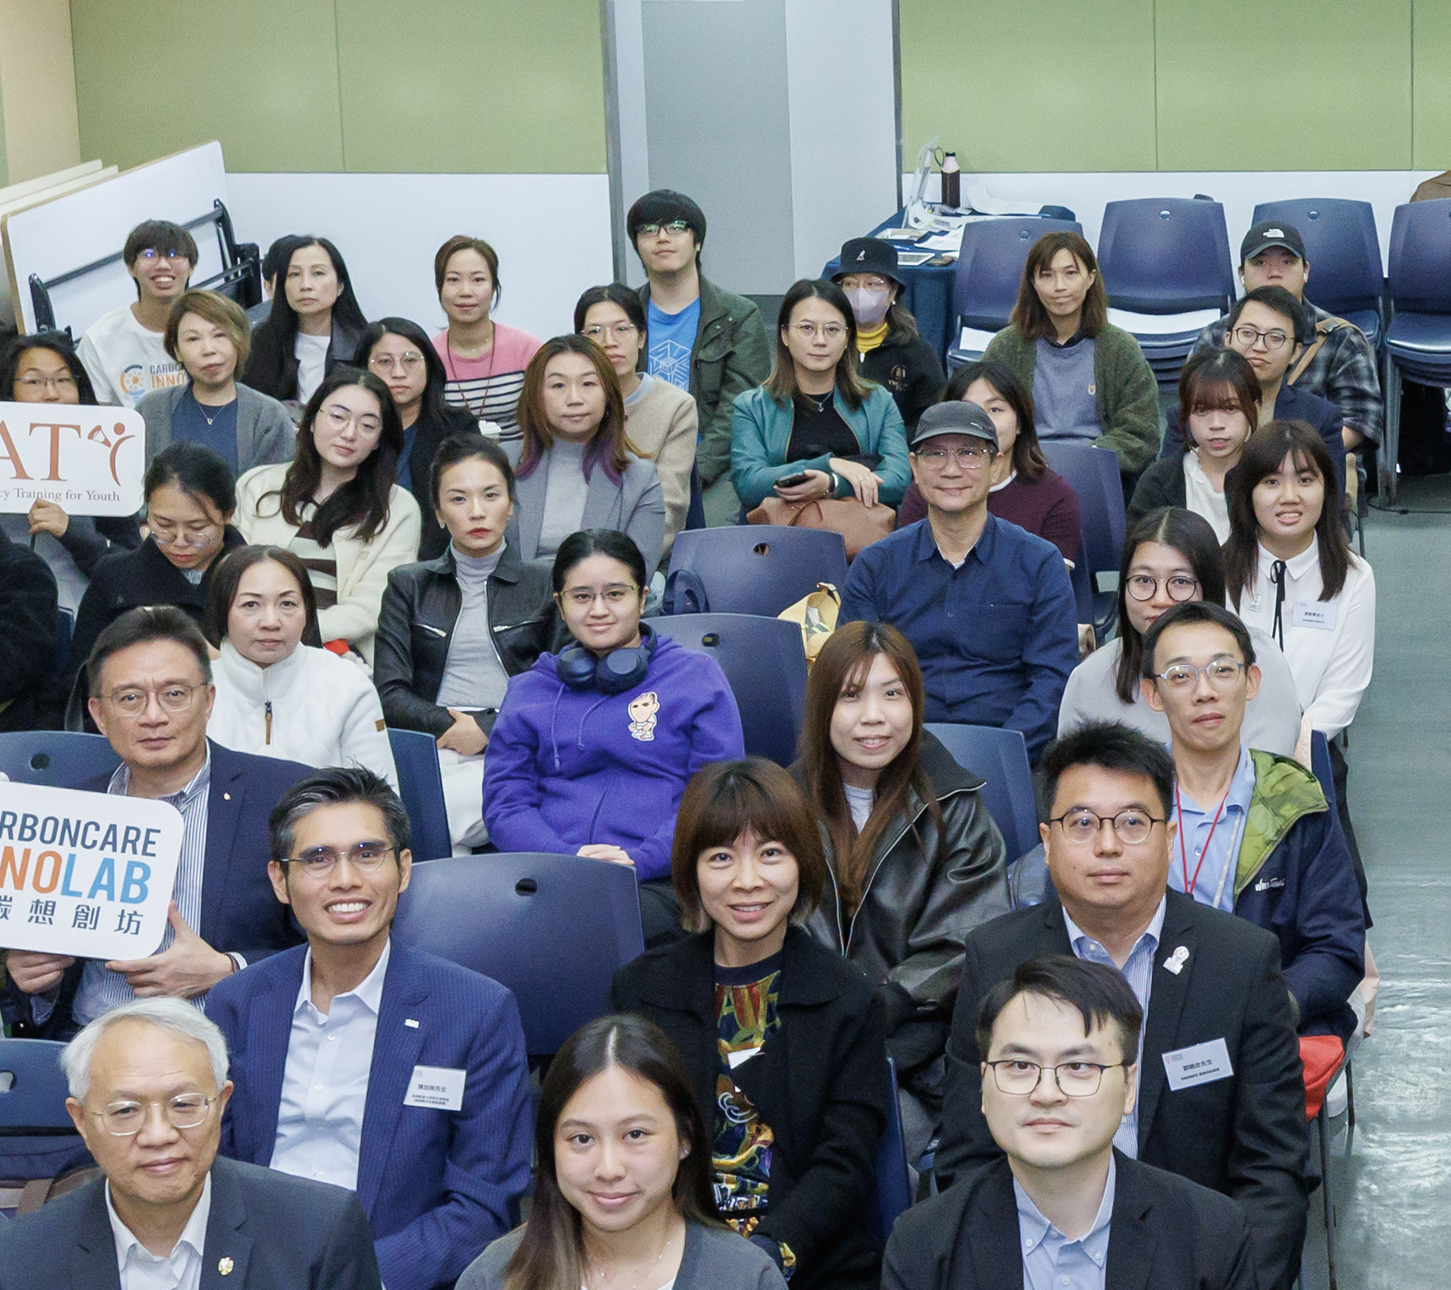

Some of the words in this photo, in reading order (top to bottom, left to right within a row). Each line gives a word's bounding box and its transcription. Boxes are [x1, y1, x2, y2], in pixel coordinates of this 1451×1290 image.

[149, 362, 182, 375] CARBO
[13, 487, 62, 502] Training
[65, 489, 82, 501] for
[86, 490, 121, 502] Youth
